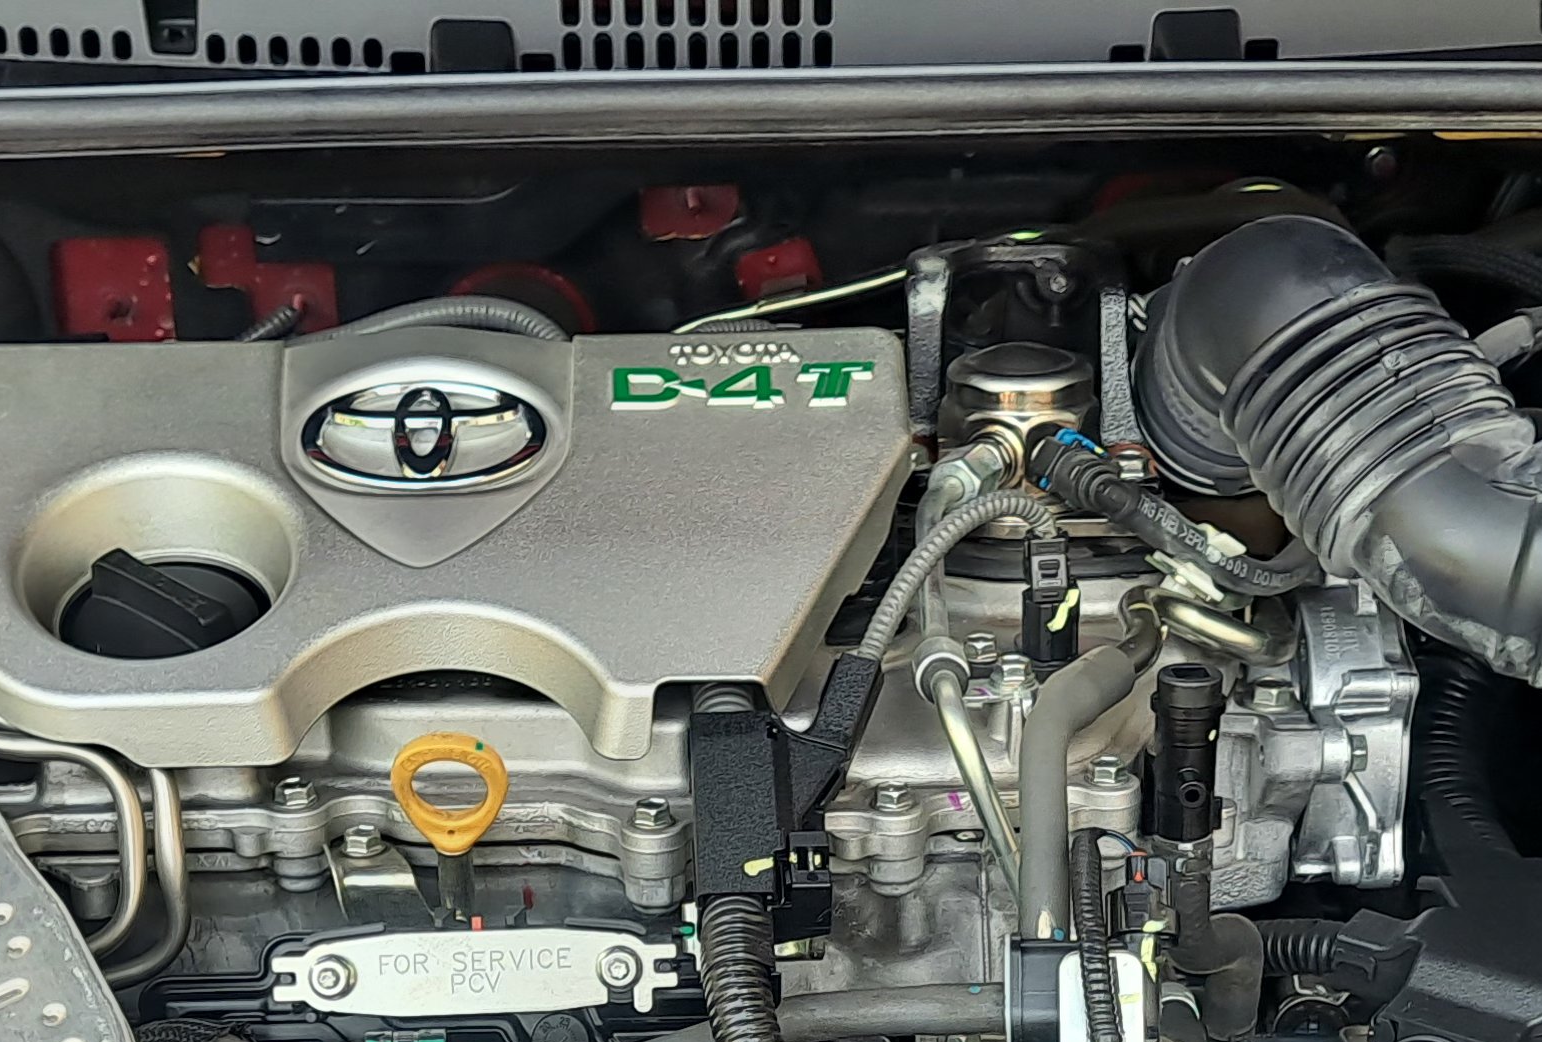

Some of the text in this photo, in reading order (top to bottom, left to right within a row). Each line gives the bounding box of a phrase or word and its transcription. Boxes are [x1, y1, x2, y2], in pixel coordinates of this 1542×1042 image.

[669, 343, 801, 366] TOYOTA
[378, 947, 571, 976] FOR SERVICE
[450, 970, 502, 994] PCV
